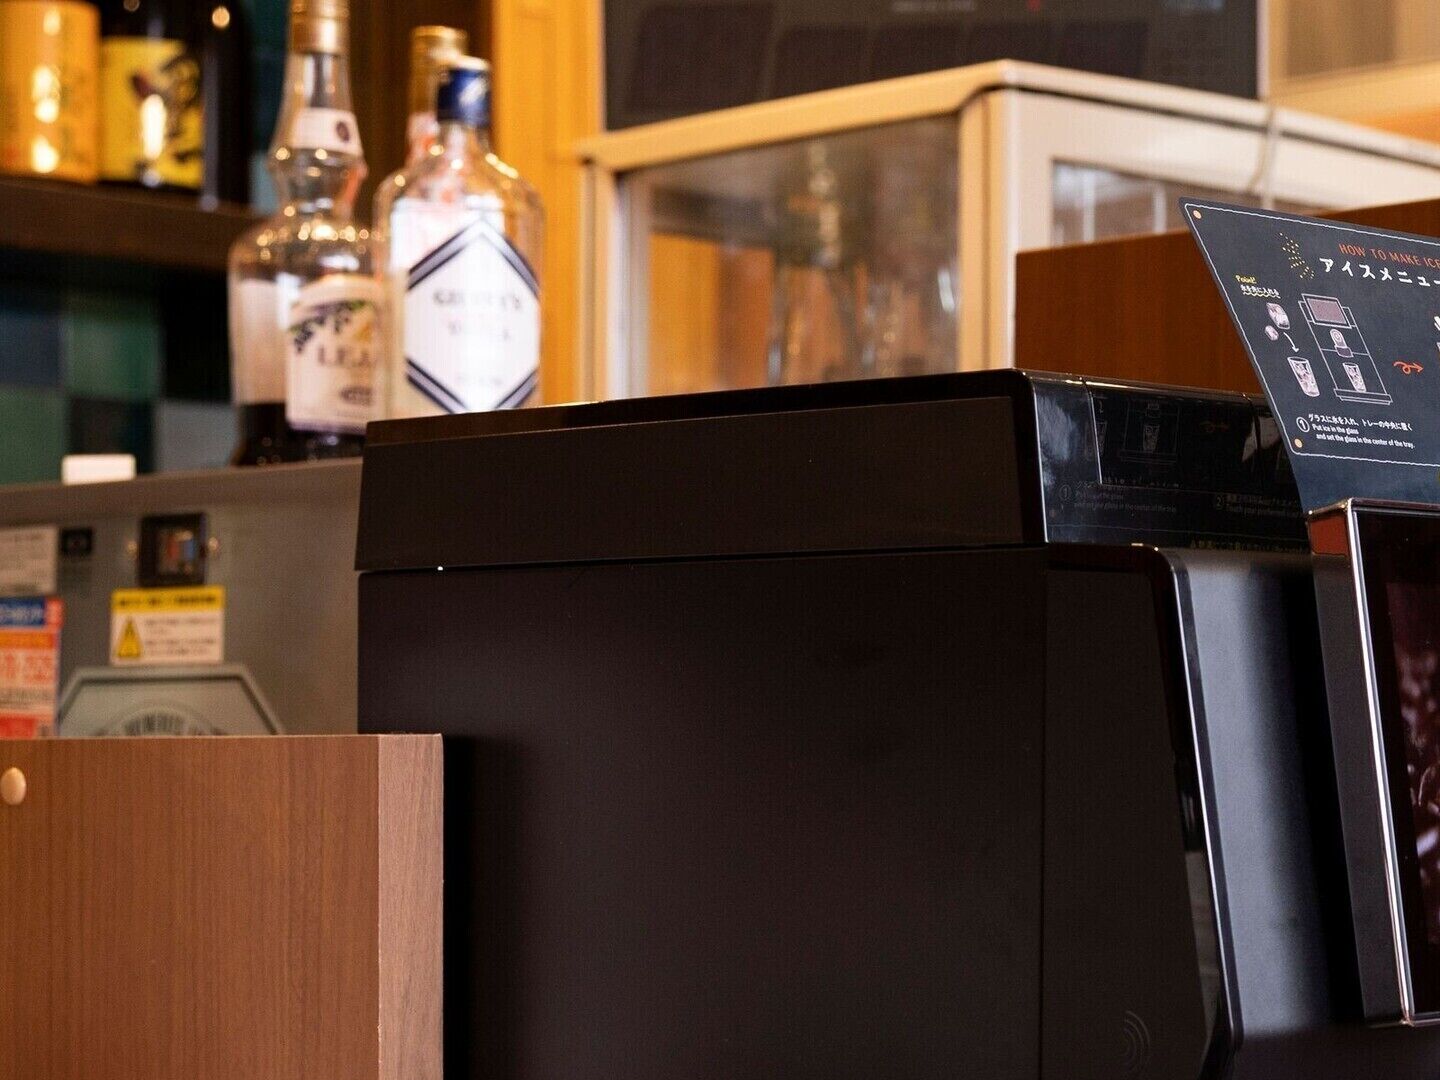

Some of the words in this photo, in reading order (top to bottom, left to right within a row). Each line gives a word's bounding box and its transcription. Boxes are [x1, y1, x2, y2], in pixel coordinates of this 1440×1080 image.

[1339, 243, 1365, 257] HOW
[1371, 248, 1387, 260] TO
[1389, 251, 1421, 266] MAKE
